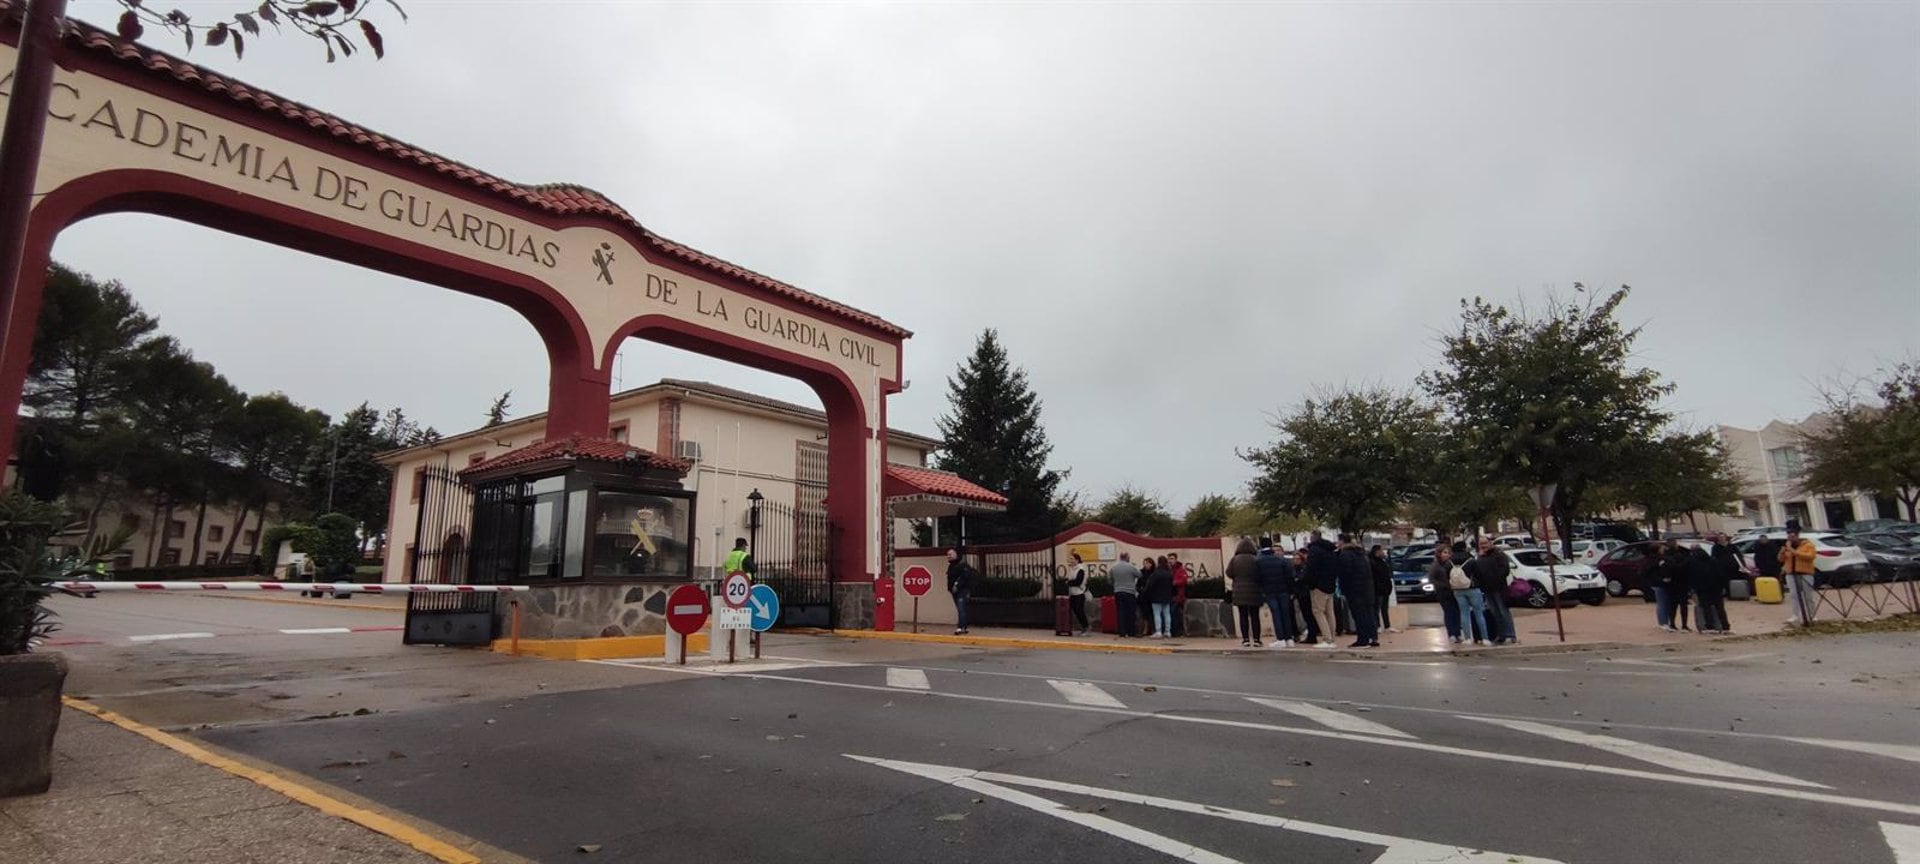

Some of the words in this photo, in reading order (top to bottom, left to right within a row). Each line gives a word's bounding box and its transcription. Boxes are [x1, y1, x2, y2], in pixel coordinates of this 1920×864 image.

[313, 166, 368, 211] DE
[379, 189, 560, 268] GUARDIAS
[646, 273, 678, 306] DE
[696, 290, 728, 321] LA
[744, 306, 831, 352] GUARDIA
[839, 336, 881, 367] CIVIL
[729, 583, 746, 596] 20
[904, 576, 930, 585] STOP
